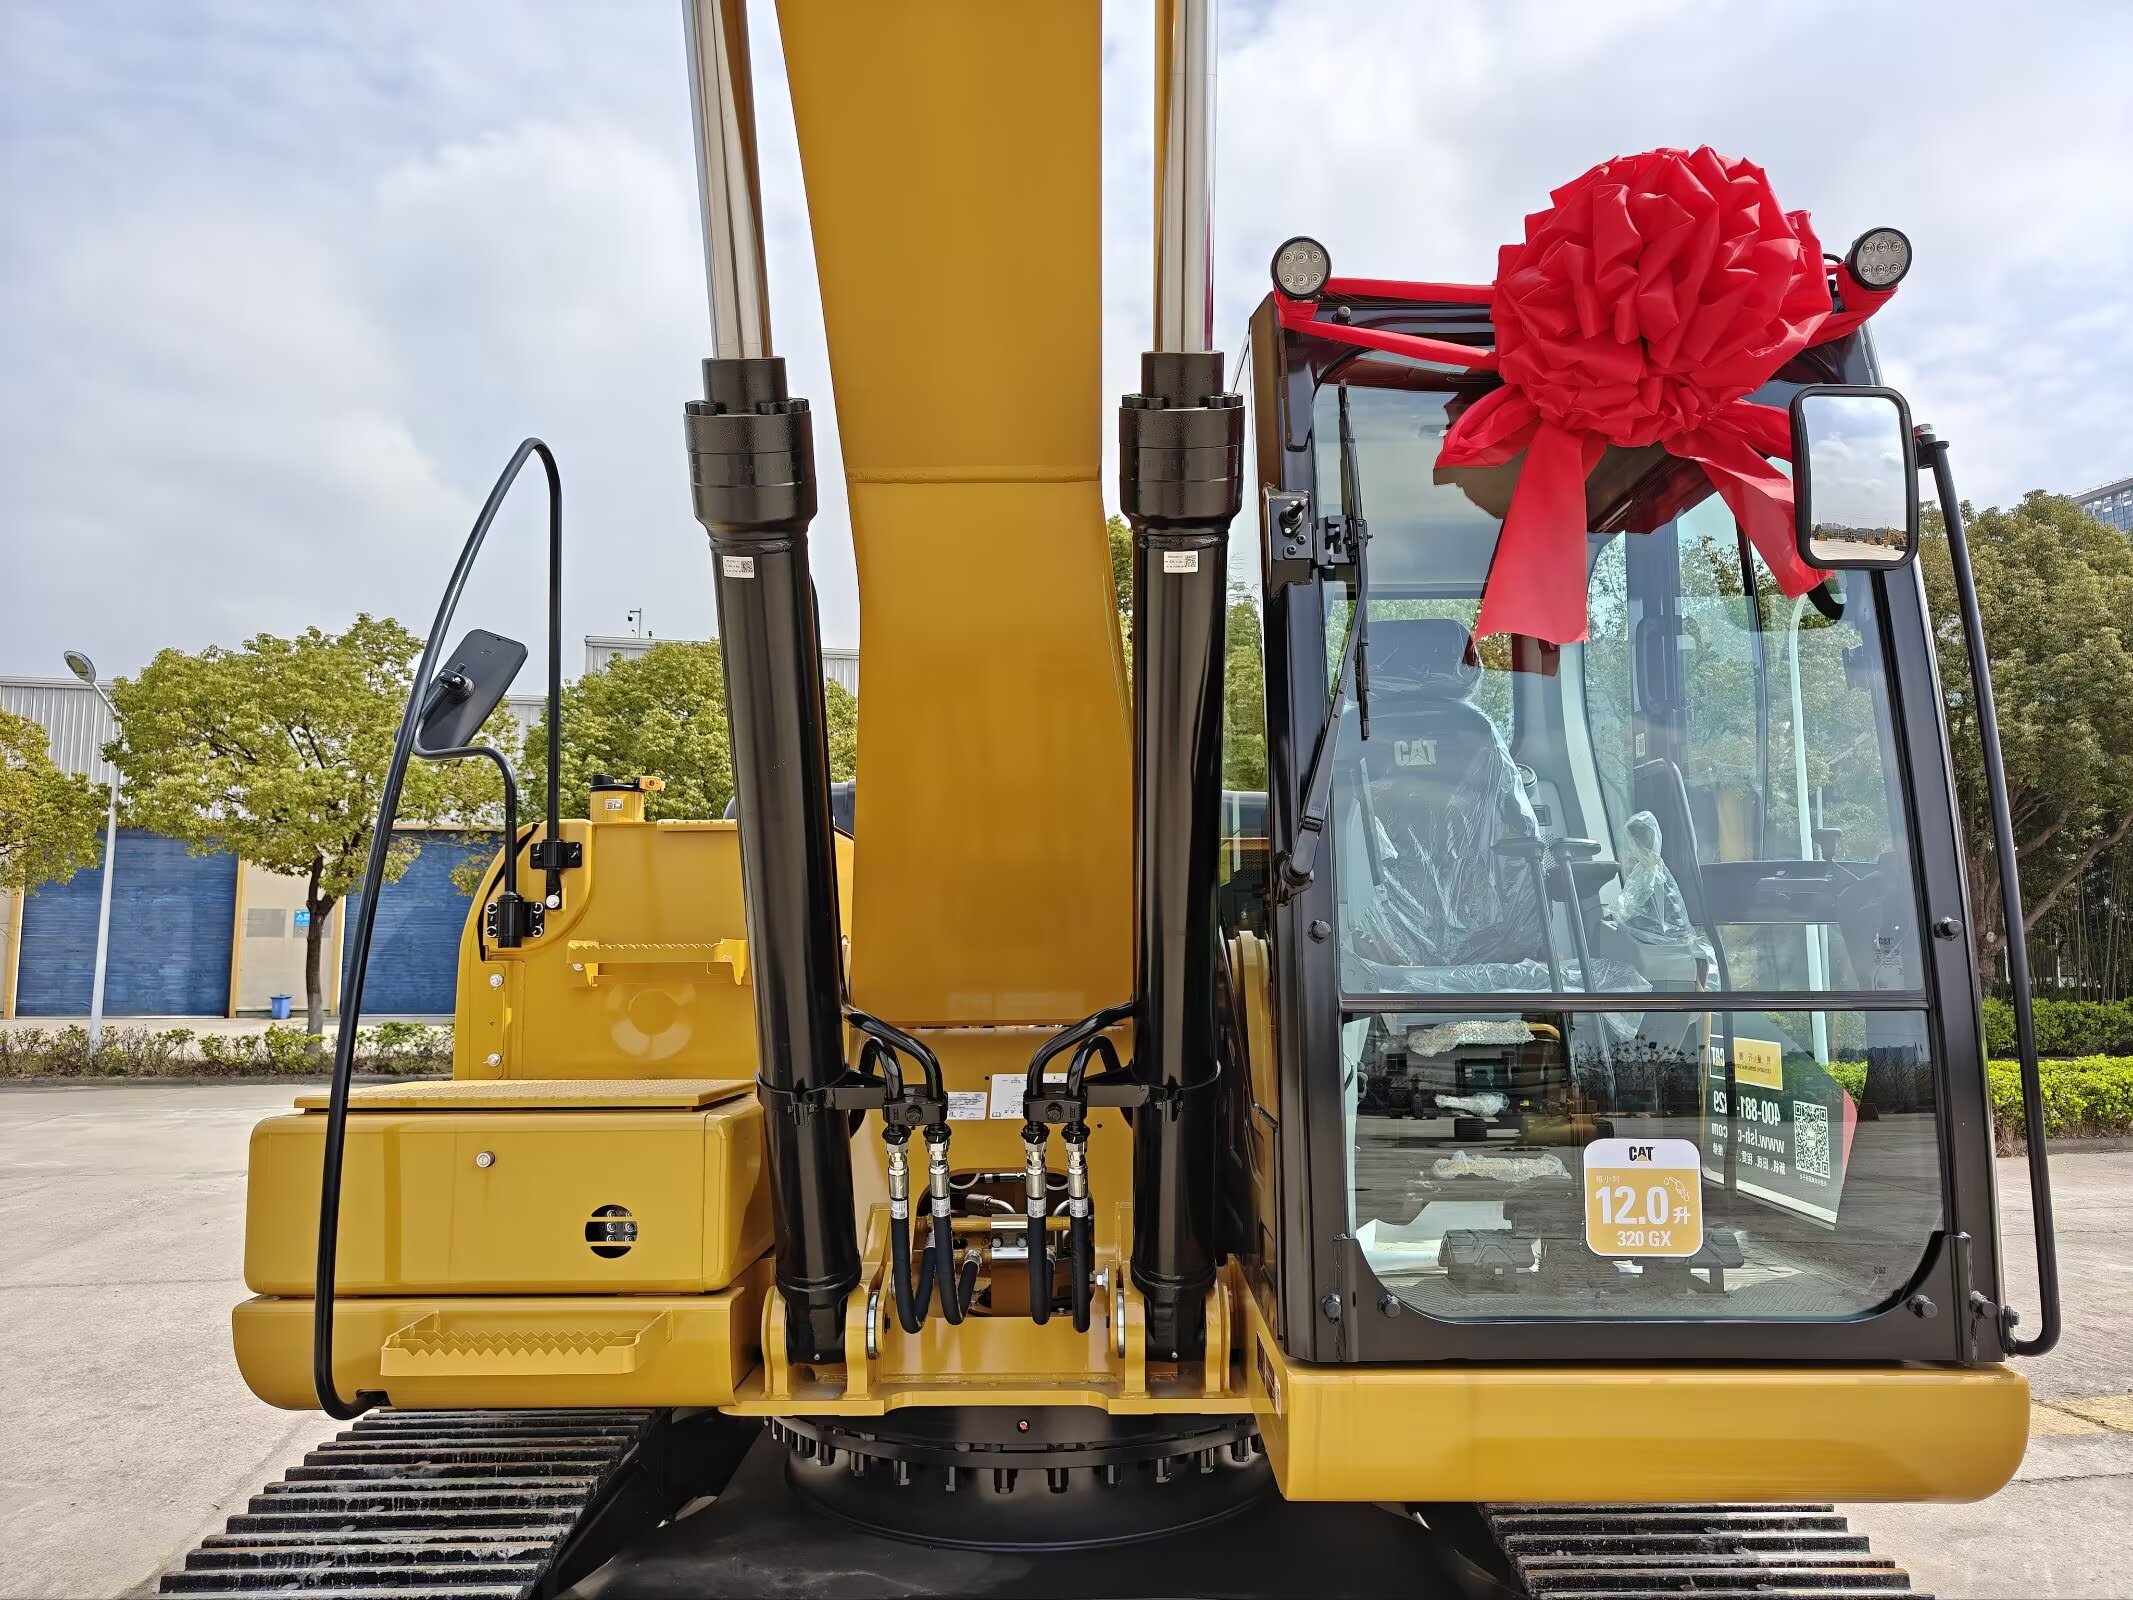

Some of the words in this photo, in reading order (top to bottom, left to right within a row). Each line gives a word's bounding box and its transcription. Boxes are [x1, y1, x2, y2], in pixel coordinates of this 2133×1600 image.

[1394, 739, 1438, 767] CAT
[1628, 1146, 1655, 1162] CAT
[1595, 1186, 1669, 1225] 12.0
[1673, 1206, 1692, 1225] 升
[1617, 1230, 1645, 1247] 320
[1648, 1230, 1673, 1247] GX
